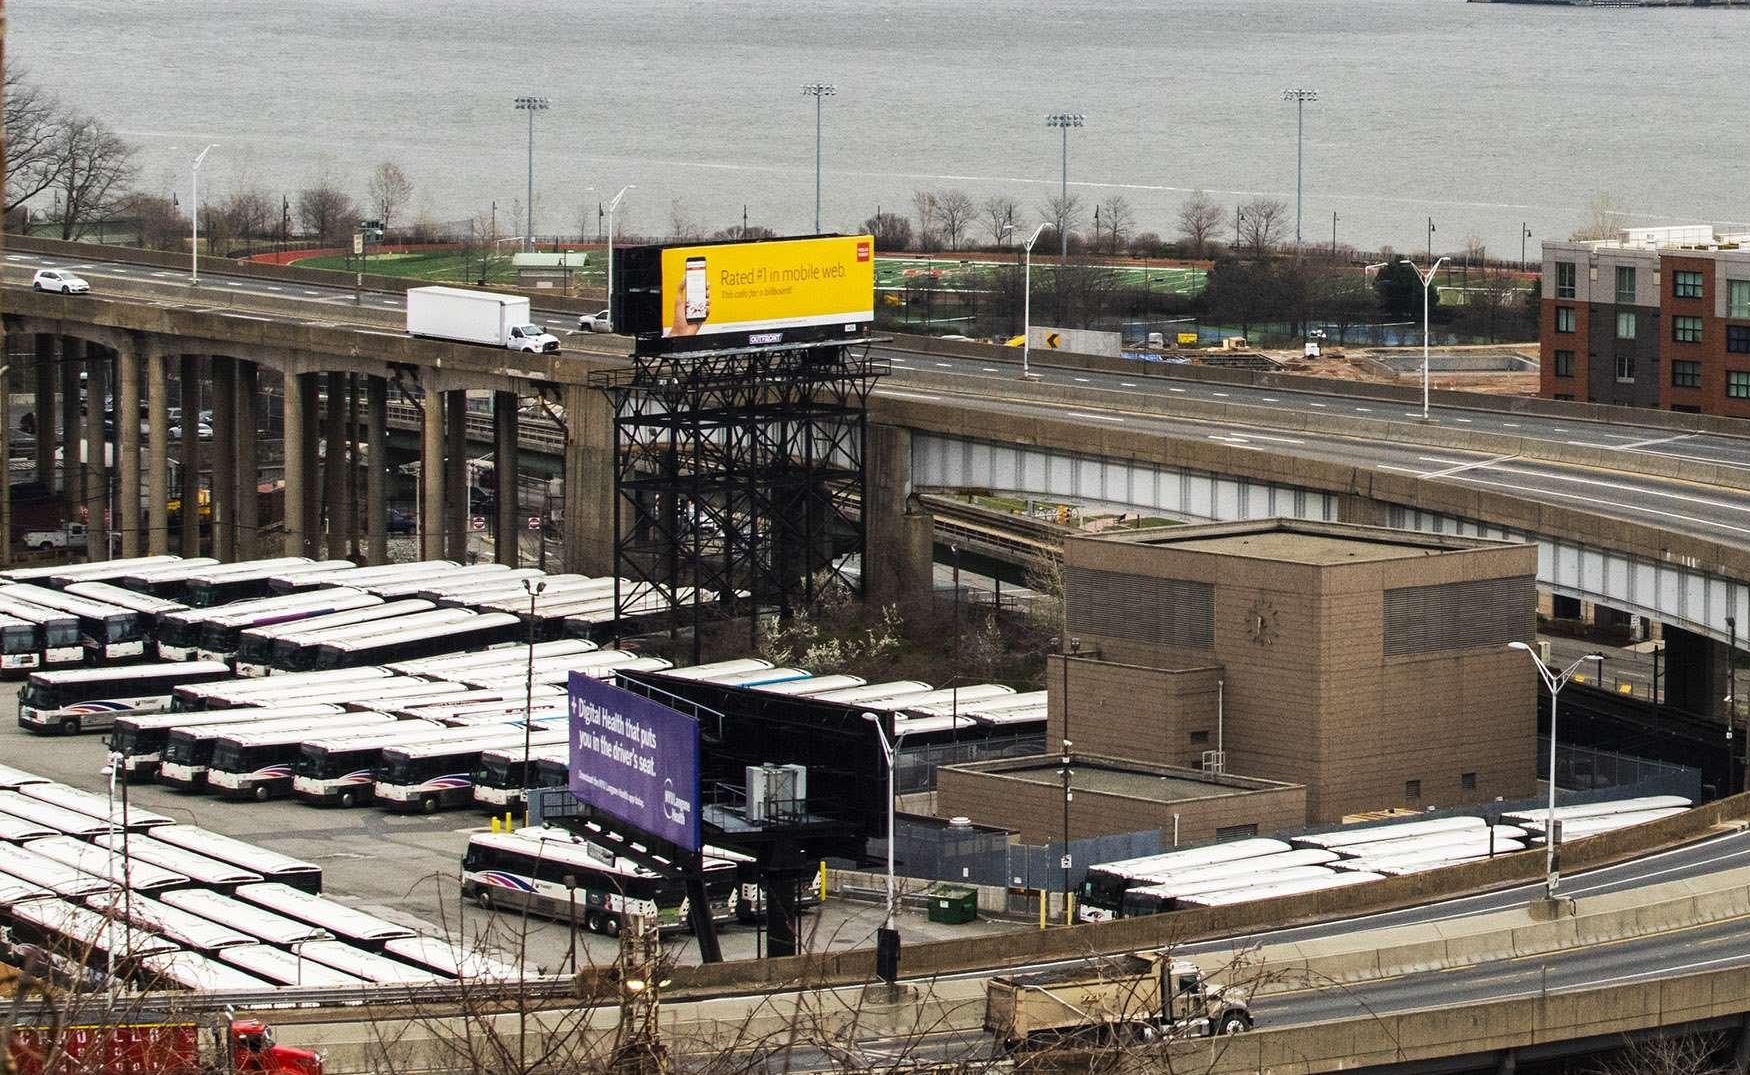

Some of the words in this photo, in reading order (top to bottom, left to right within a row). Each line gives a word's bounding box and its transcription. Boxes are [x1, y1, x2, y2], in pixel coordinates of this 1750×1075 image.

[721, 268, 754, 286] Rated
[757, 267, 768, 283] #1
[770, 269, 780, 282] in
[782, 263, 820, 281] mobile
[579, 697, 601, 726] Digital
[602, 707, 624, 735] Health
[625, 718, 640, 742] that
[640, 727, 657, 749] puts
[579, 730, 592, 750] you
[592, 731, 600, 753] in
[600, 735, 612, 758] the
[612, 741, 638, 769] driver's
[638, 756, 657, 777] seat.
